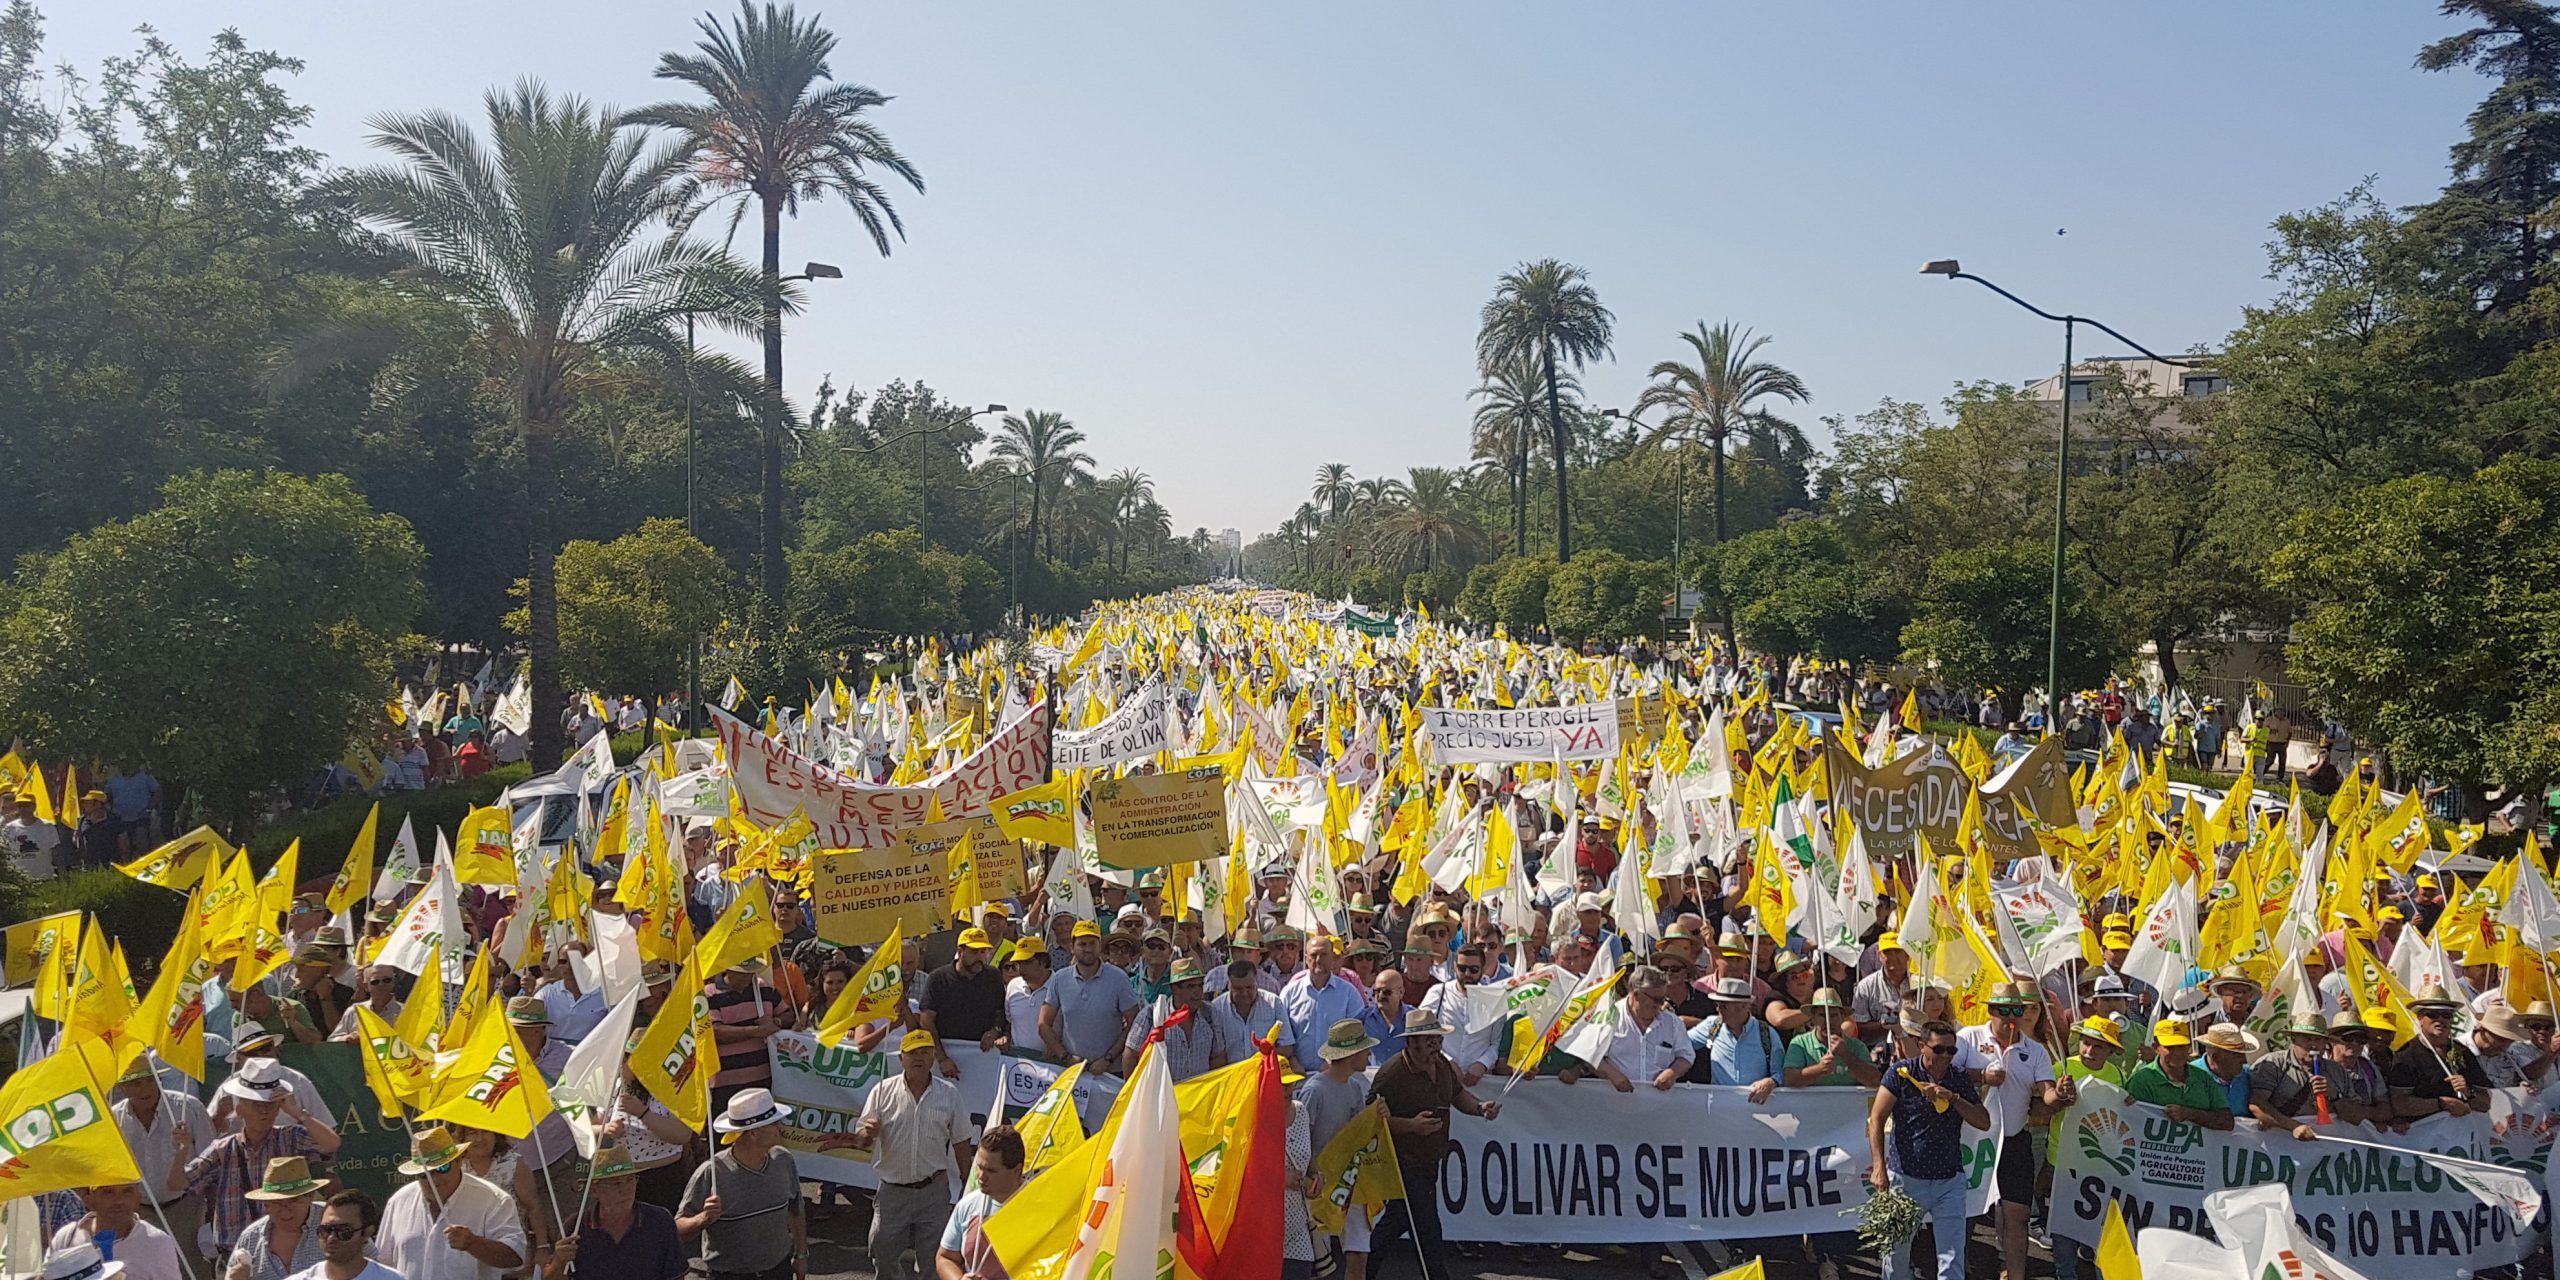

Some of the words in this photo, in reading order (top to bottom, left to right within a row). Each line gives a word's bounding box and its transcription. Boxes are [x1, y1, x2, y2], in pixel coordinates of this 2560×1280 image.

[1434, 706, 1600, 728] TORREPEROGIL
[1099, 741, 1116, 758] DE
[1121, 722, 1165, 751] OLIVA
[1187, 767, 1221, 780] COAG
[1133, 794, 1179, 806] CONTROL
[1181, 791, 1195, 800] DE
[1196, 789, 1209, 798] LA
[1119, 801, 1202, 819] ADMINISTRACIÓN
[1102, 823, 1115, 832] EN
[1117, 821, 1130, 830] LA
[1132, 809, 1221, 828] TRANSFORMACIÓN
[1111, 833, 1118, 841] Y
[1119, 821, 1214, 841] COMERCIALIZACIÓN
[911, 841, 945, 853] COAG
[1870, 839, 1885, 849] LA
[835, 870, 892, 885] DEFENSA
[895, 867, 911, 877] DE
[914, 863, 930, 874] LA
[825, 885, 880, 900] CALIDAD
[884, 883, 891, 892] Y
[893, 876, 941, 890] PUREZA
[822, 904, 838, 915] DE
[842, 896, 901, 911] NUESTRO
[903, 888, 946, 903] ACEITE
[813, 1042, 888, 1088] UPA
[1015, 1073, 1033, 1089] ES
[2143, 1117, 2204, 1153] UPA
[371, 1154, 388, 1168] de
[2140, 1151, 2162, 1161] Unión
[2163, 1155, 2173, 1163] de
[2140, 1160, 2206, 1174] AGRICULTORES
[1481, 1141, 1622, 1217] OLIVAR
[1635, 1143, 1687, 1218] SE
[1699, 1144, 1842, 1218] MUERE
[2148, 1168, 2204, 1183] GANADEROS
[2392, 1207, 2473, 1255] HAY
